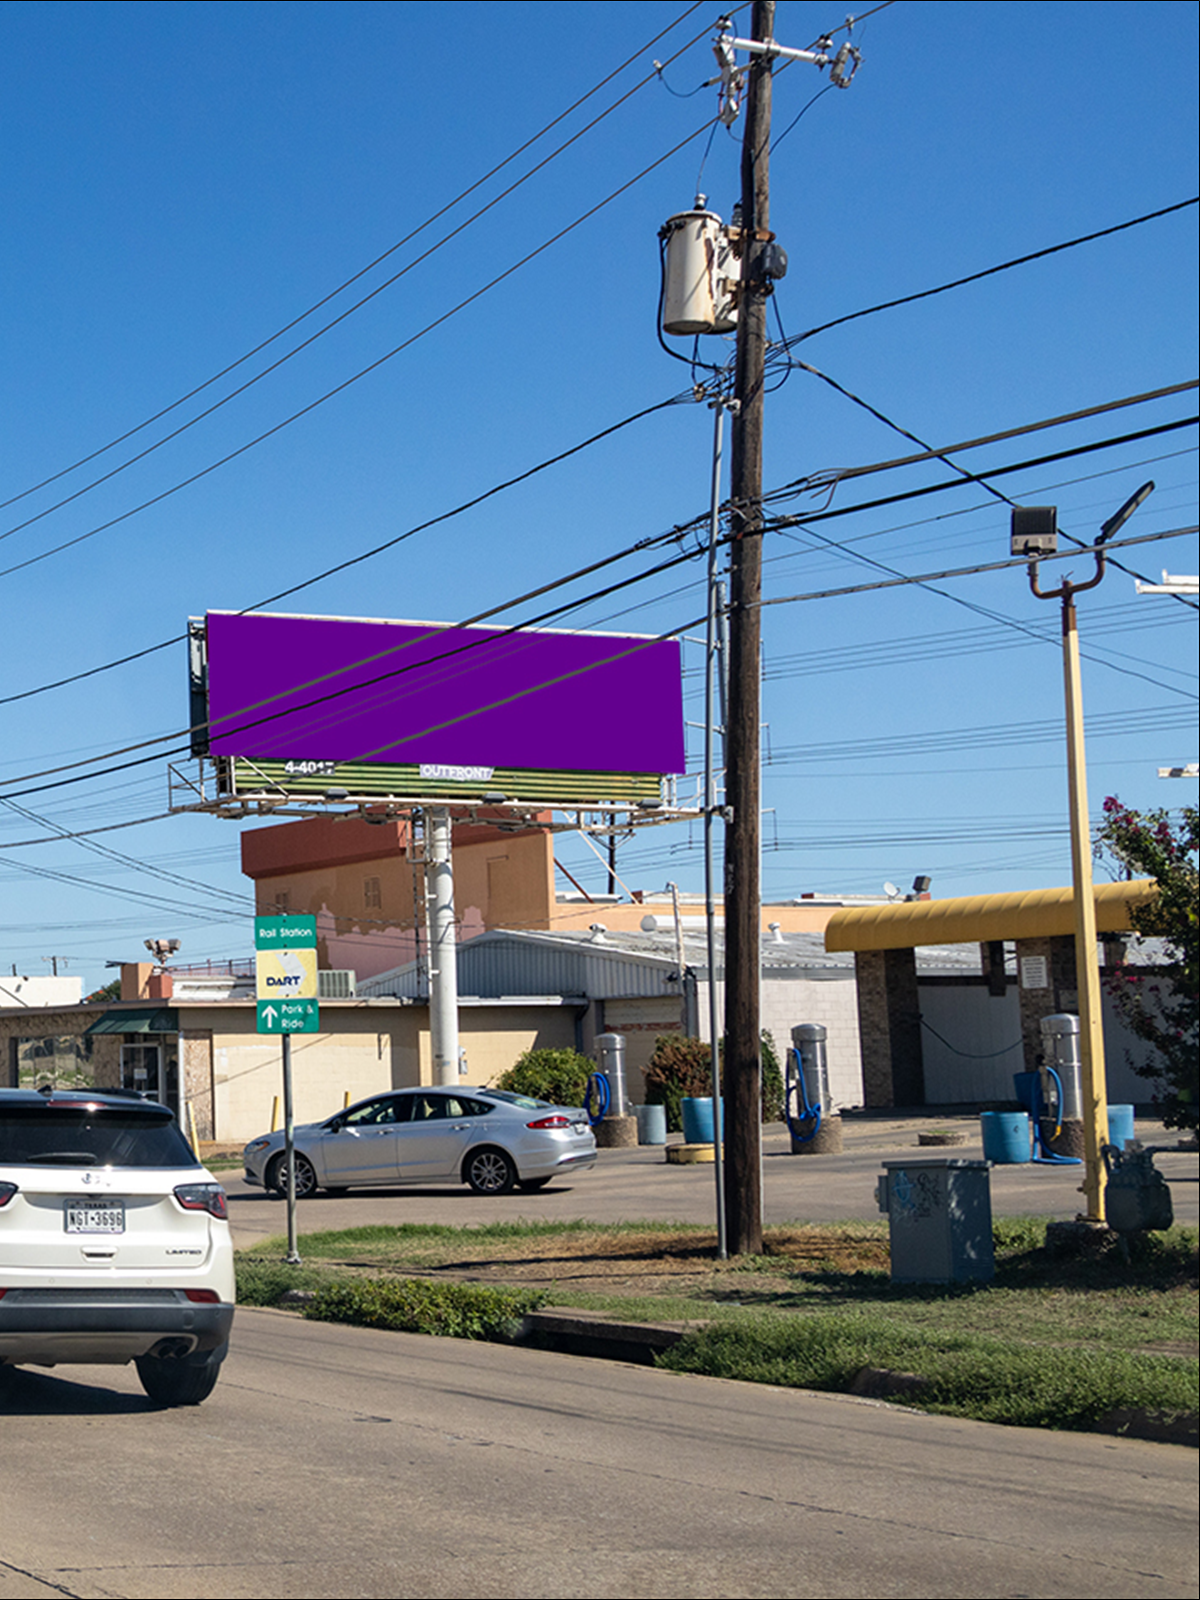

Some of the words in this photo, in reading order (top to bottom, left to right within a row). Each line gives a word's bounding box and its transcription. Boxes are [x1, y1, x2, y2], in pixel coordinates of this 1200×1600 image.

[259, 928, 276, 938] Rail
[280, 928, 312, 938] Station
[266, 976, 300, 986] DART
[281, 1005, 304, 1014] Park
[306, 1004, 314, 1014] &
[281, 1019, 304, 1028] Ride
